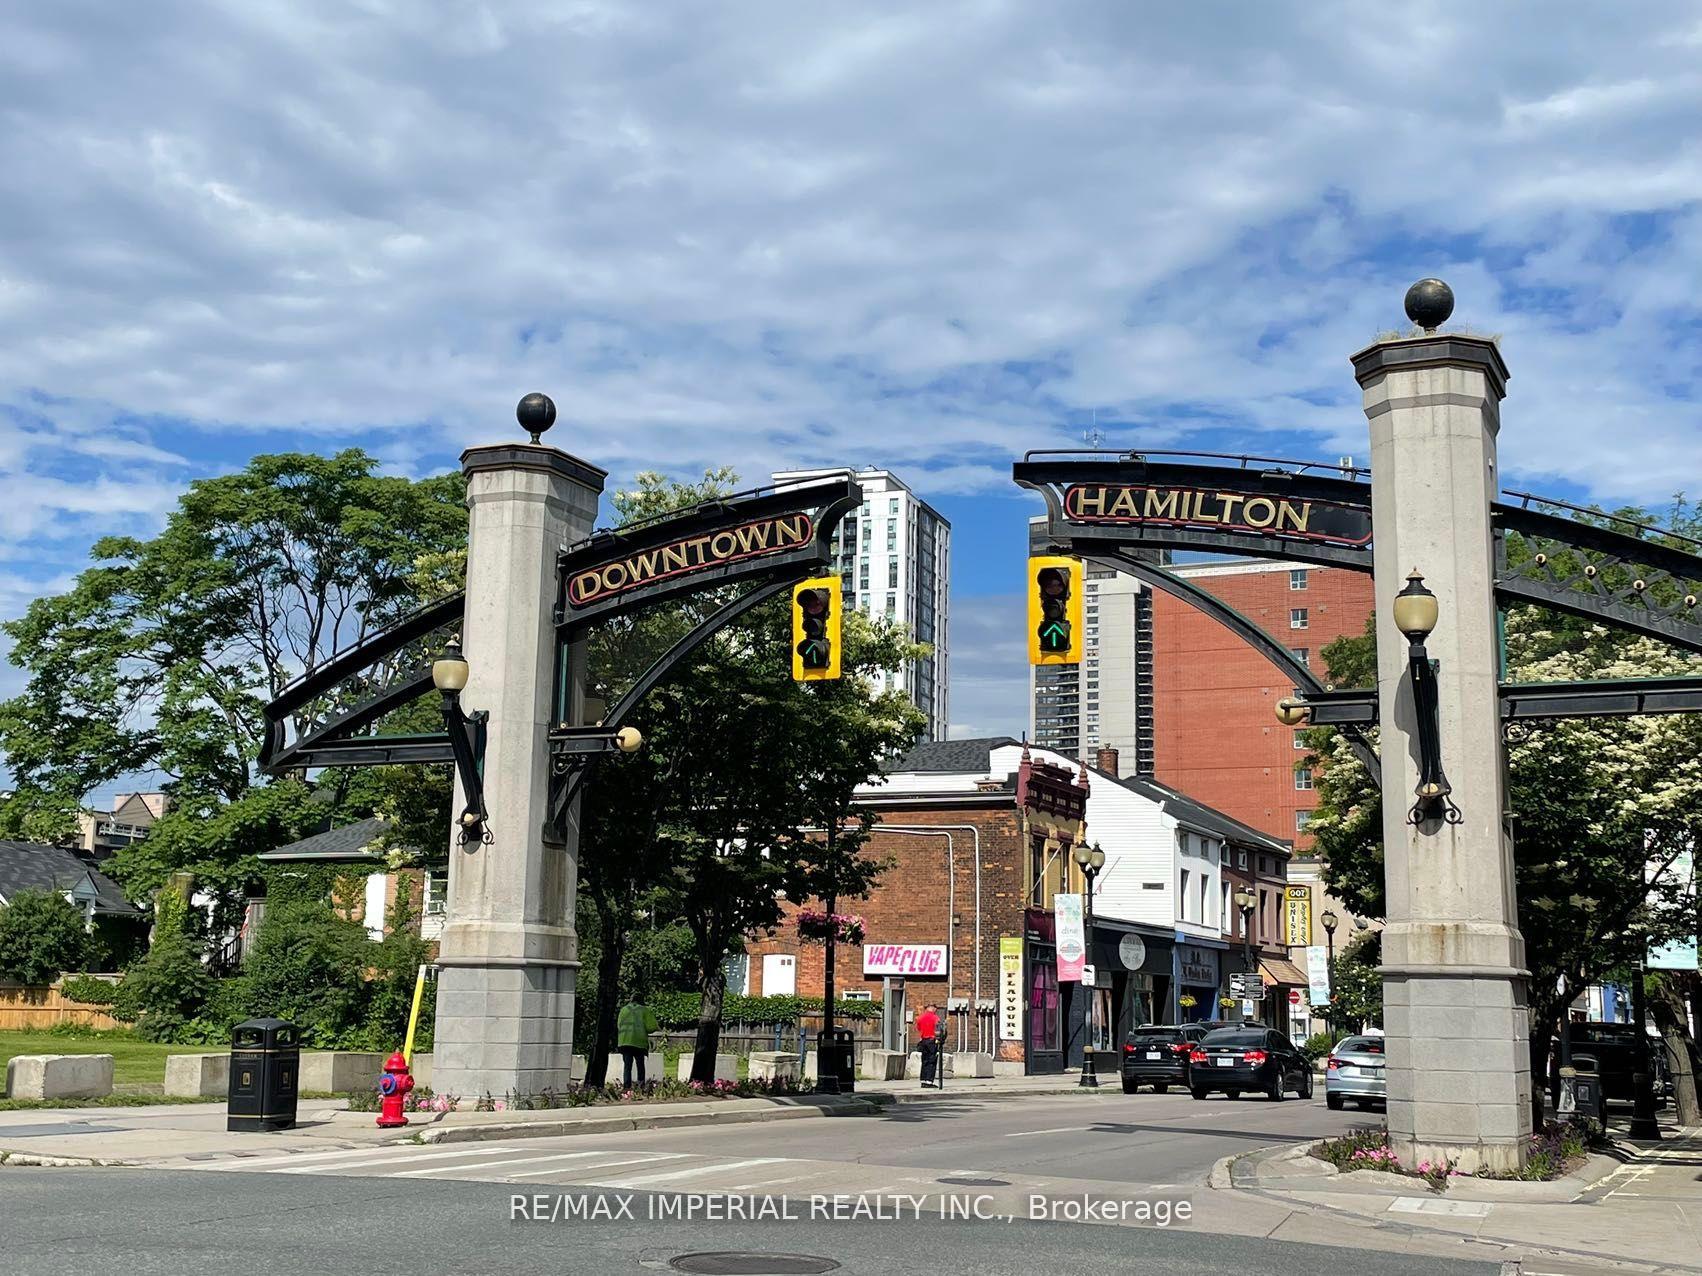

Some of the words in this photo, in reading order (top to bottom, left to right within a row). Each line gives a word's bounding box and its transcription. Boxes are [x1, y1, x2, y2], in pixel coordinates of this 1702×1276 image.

[1075, 487, 1312, 532] HAMILTON
[576, 515, 804, 600] DOWNTOWN
[868, 946, 903, 965] VAPE
[898, 950, 942, 972] CLUB
[1006, 972, 1016, 1037] FLAVOURS
